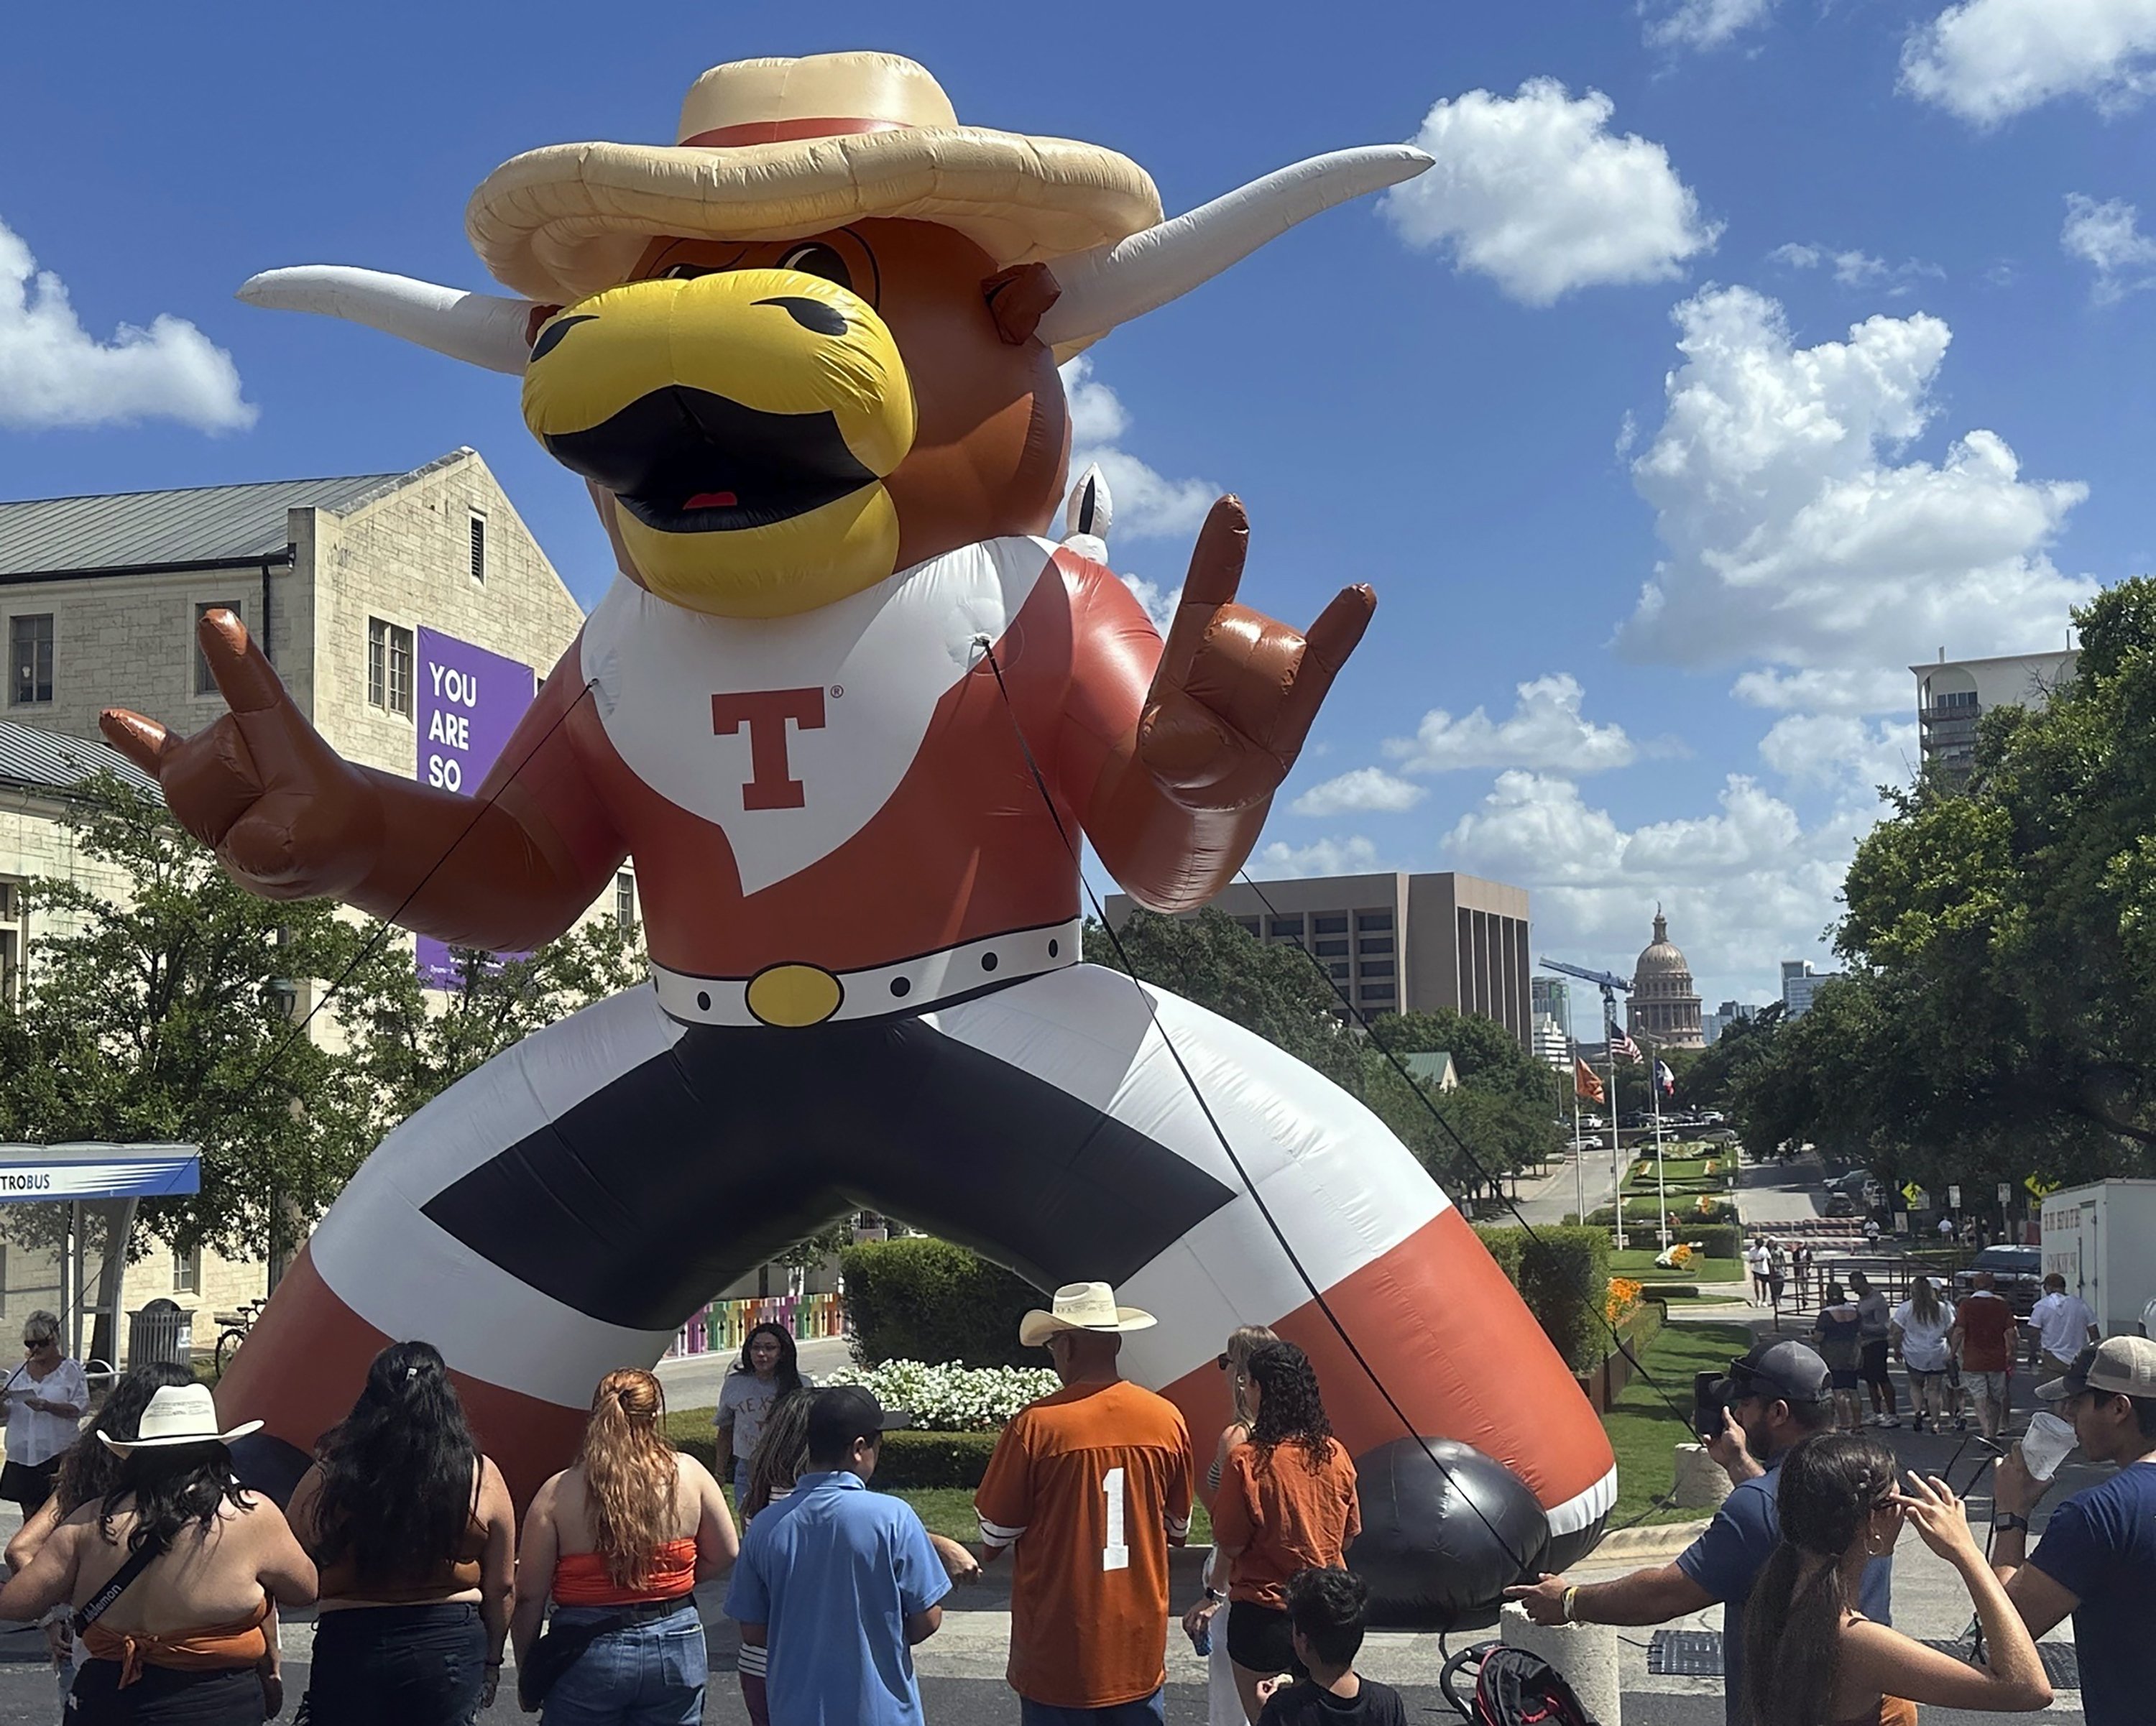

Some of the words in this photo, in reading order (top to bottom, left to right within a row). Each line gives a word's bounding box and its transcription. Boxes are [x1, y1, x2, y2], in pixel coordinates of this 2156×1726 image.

[429, 661, 476, 708] YOU
[428, 709, 469, 751] ARE
[711, 686, 826, 811] T
[428, 754, 461, 793] SO
[0, 1173, 50, 1190] TROBUS
[1102, 1467, 1129, 1572] 1
